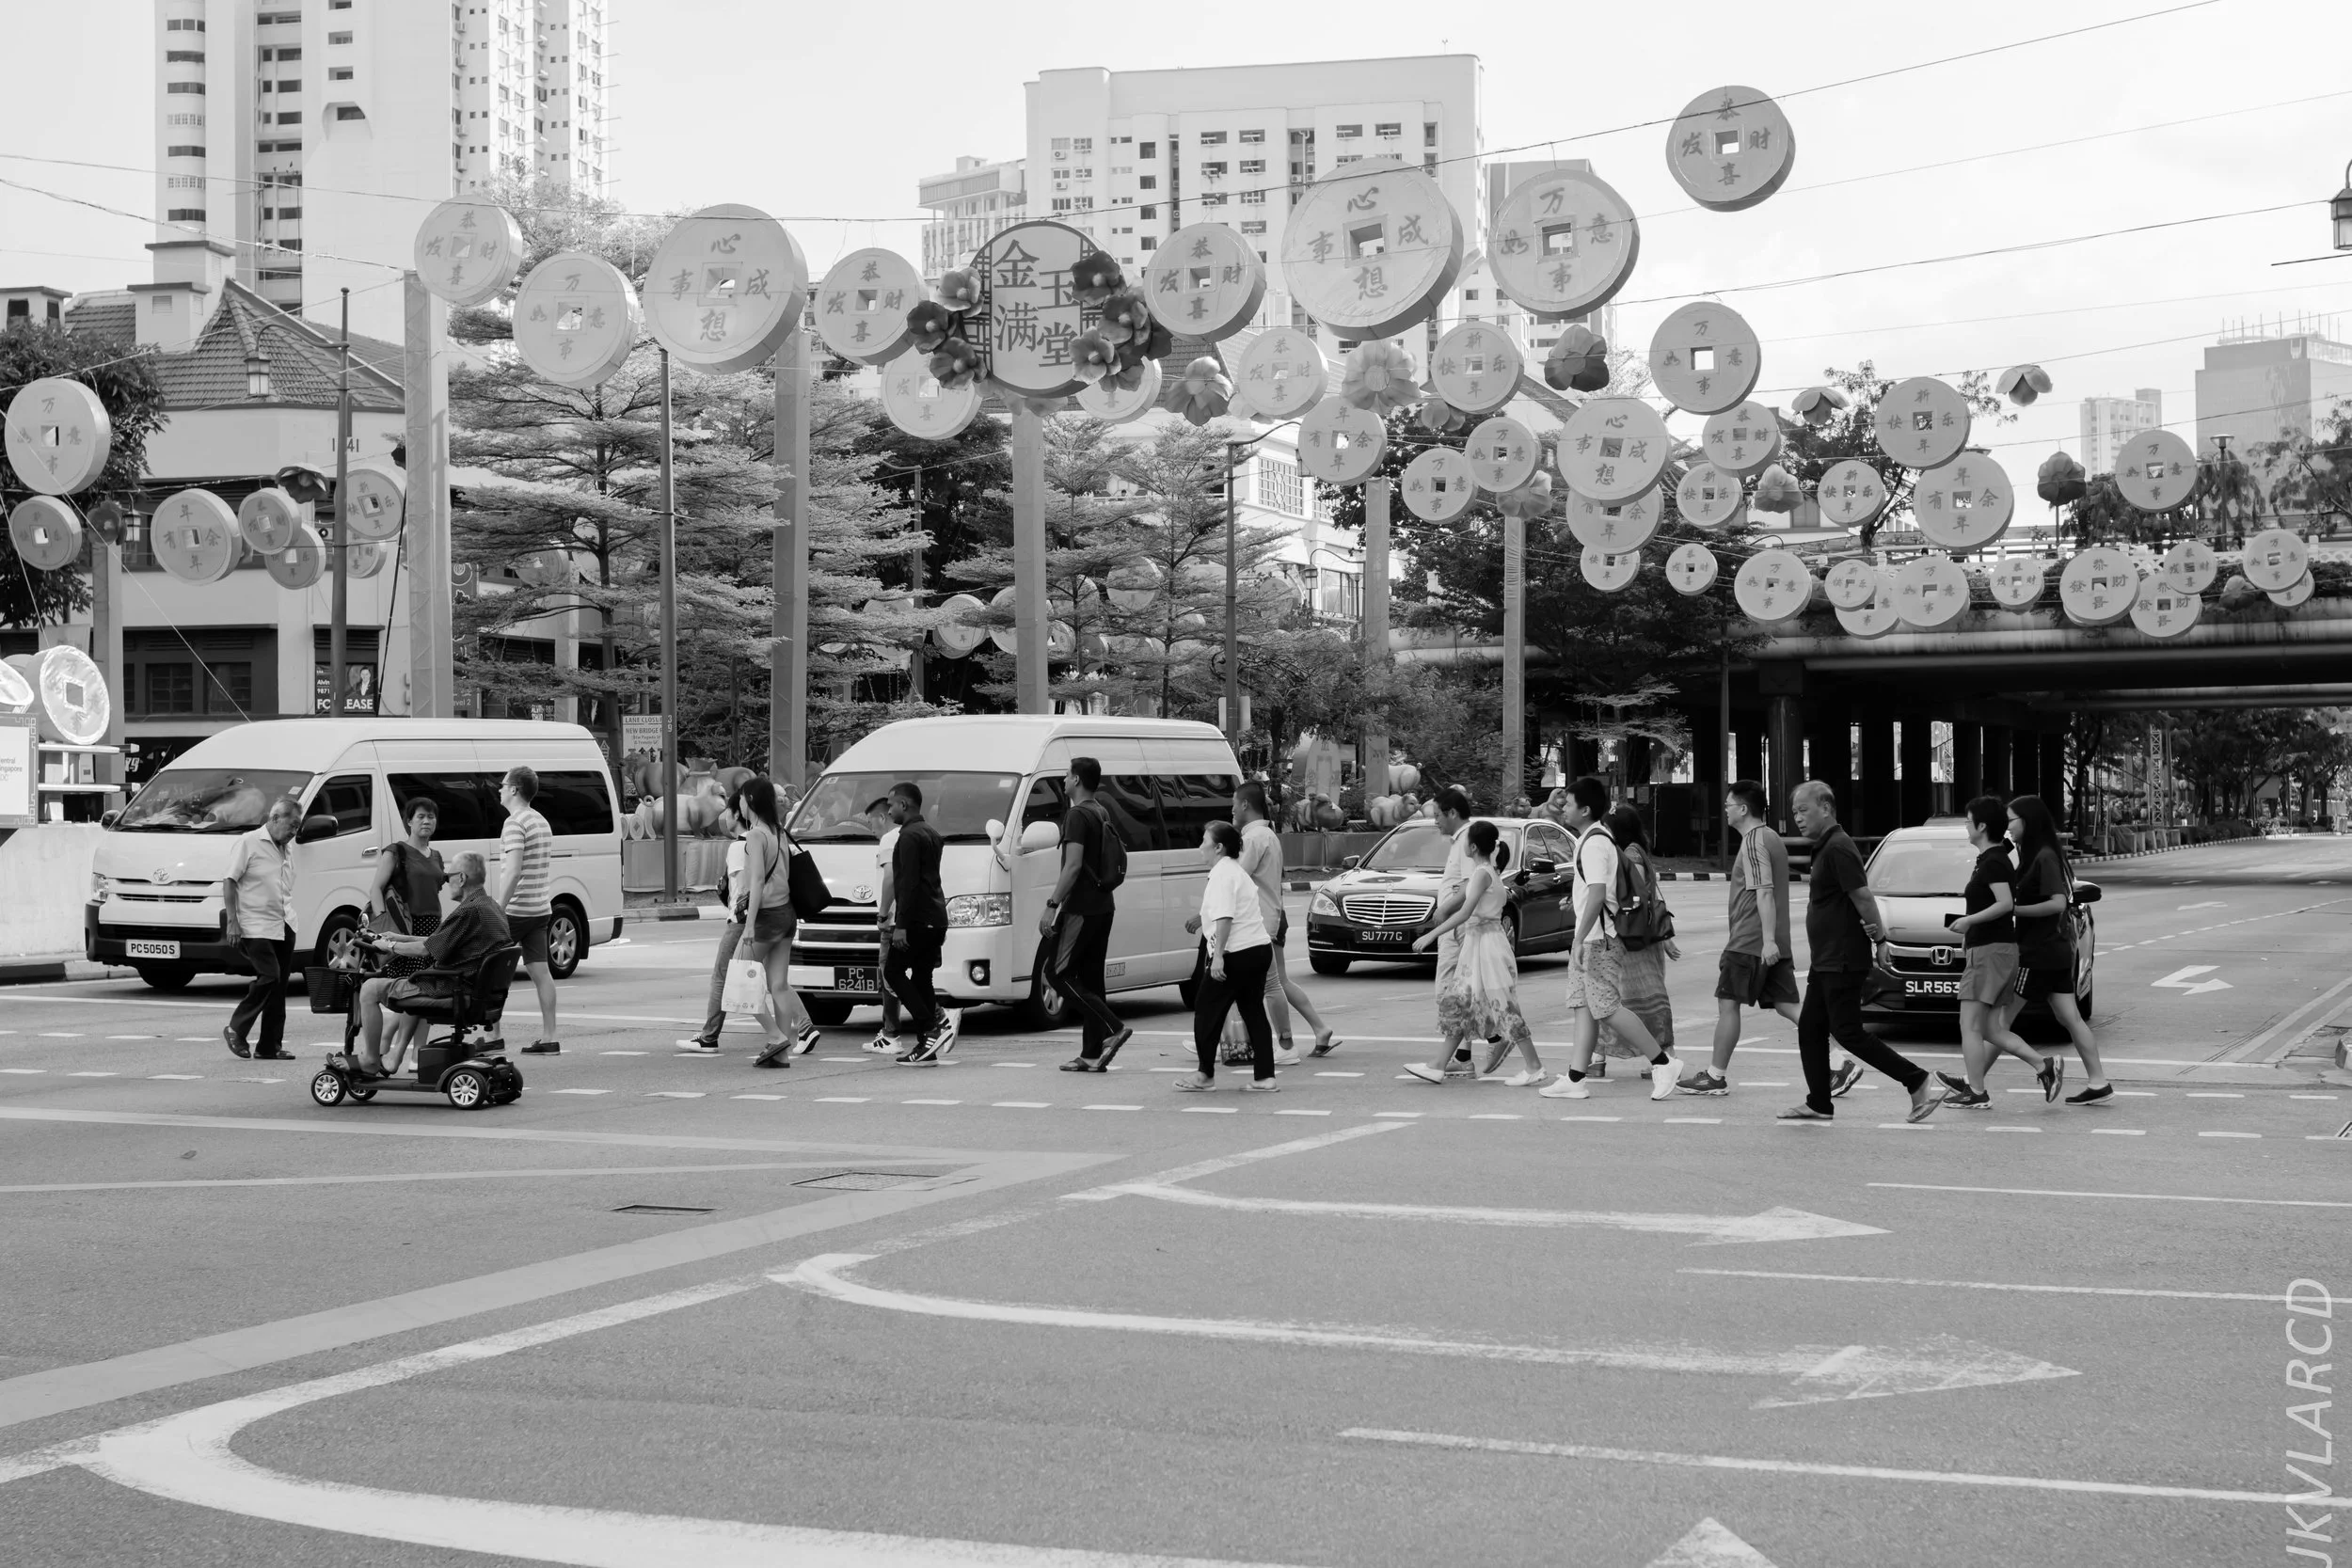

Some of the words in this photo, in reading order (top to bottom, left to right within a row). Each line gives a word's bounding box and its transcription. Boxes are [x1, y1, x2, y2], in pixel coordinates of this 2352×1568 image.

[332, 437, 360, 452] 141
[343, 698, 373, 710] EASE
[849, 968, 865, 979] PC
[838, 978, 875, 990] 6241B
